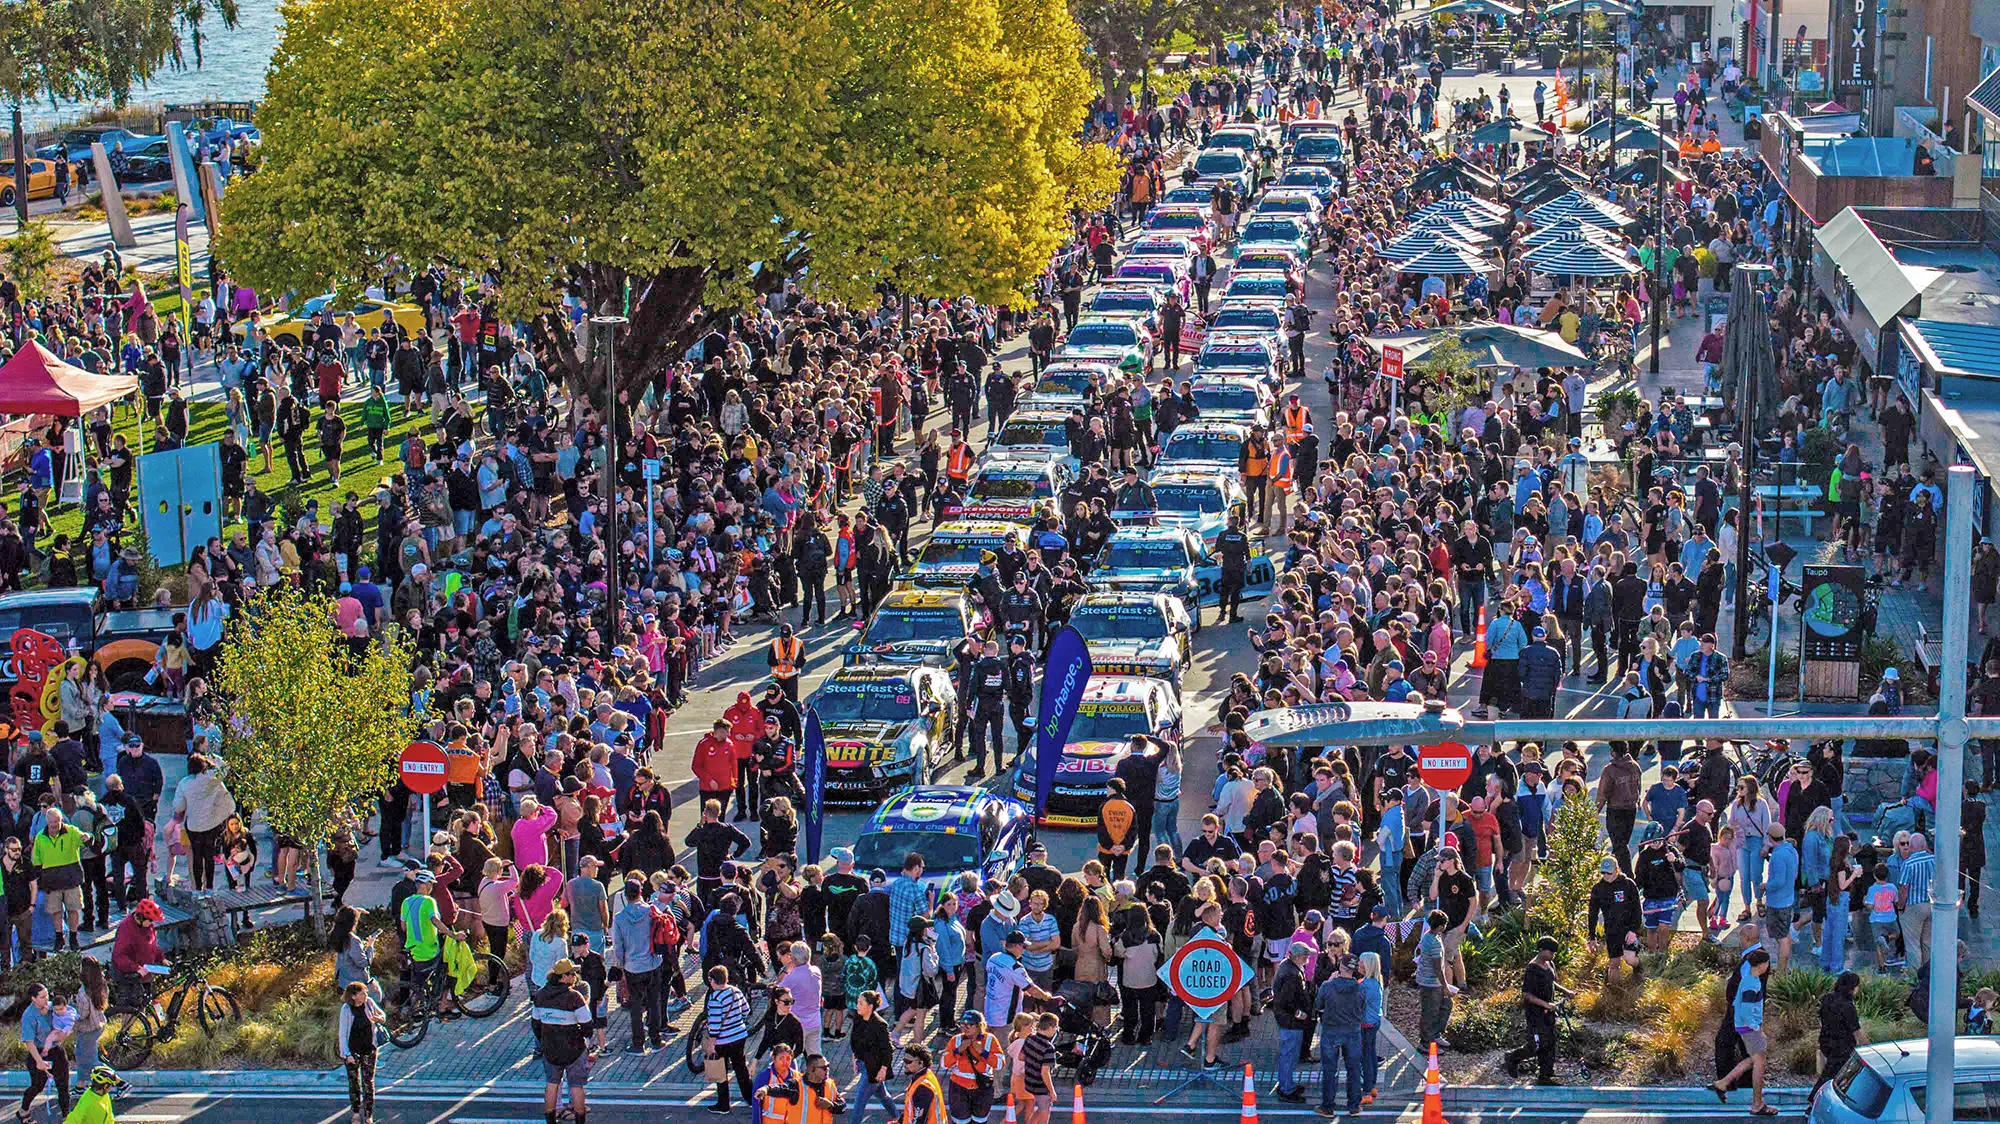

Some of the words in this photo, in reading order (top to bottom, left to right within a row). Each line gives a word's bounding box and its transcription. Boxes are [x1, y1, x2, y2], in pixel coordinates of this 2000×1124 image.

[1384, 349, 1402, 362] WRONG
[1386, 363, 1398, 375] WAY
[1080, 606, 1142, 615] Steadfast
[850, 643, 913, 653] GROVE
[826, 684, 893, 694] Steadfast
[1098, 704, 1142, 712] STORAGE
[826, 746, 898, 761] NRITE
[407, 763, 416, 771] NO
[420, 763, 439, 772] ENTRY
[1427, 759, 1437, 767] NO
[1440, 759, 1461, 767] ENTRY
[1192, 960, 1221, 973] ROAD
[1186, 975, 1227, 988] CLOSED
